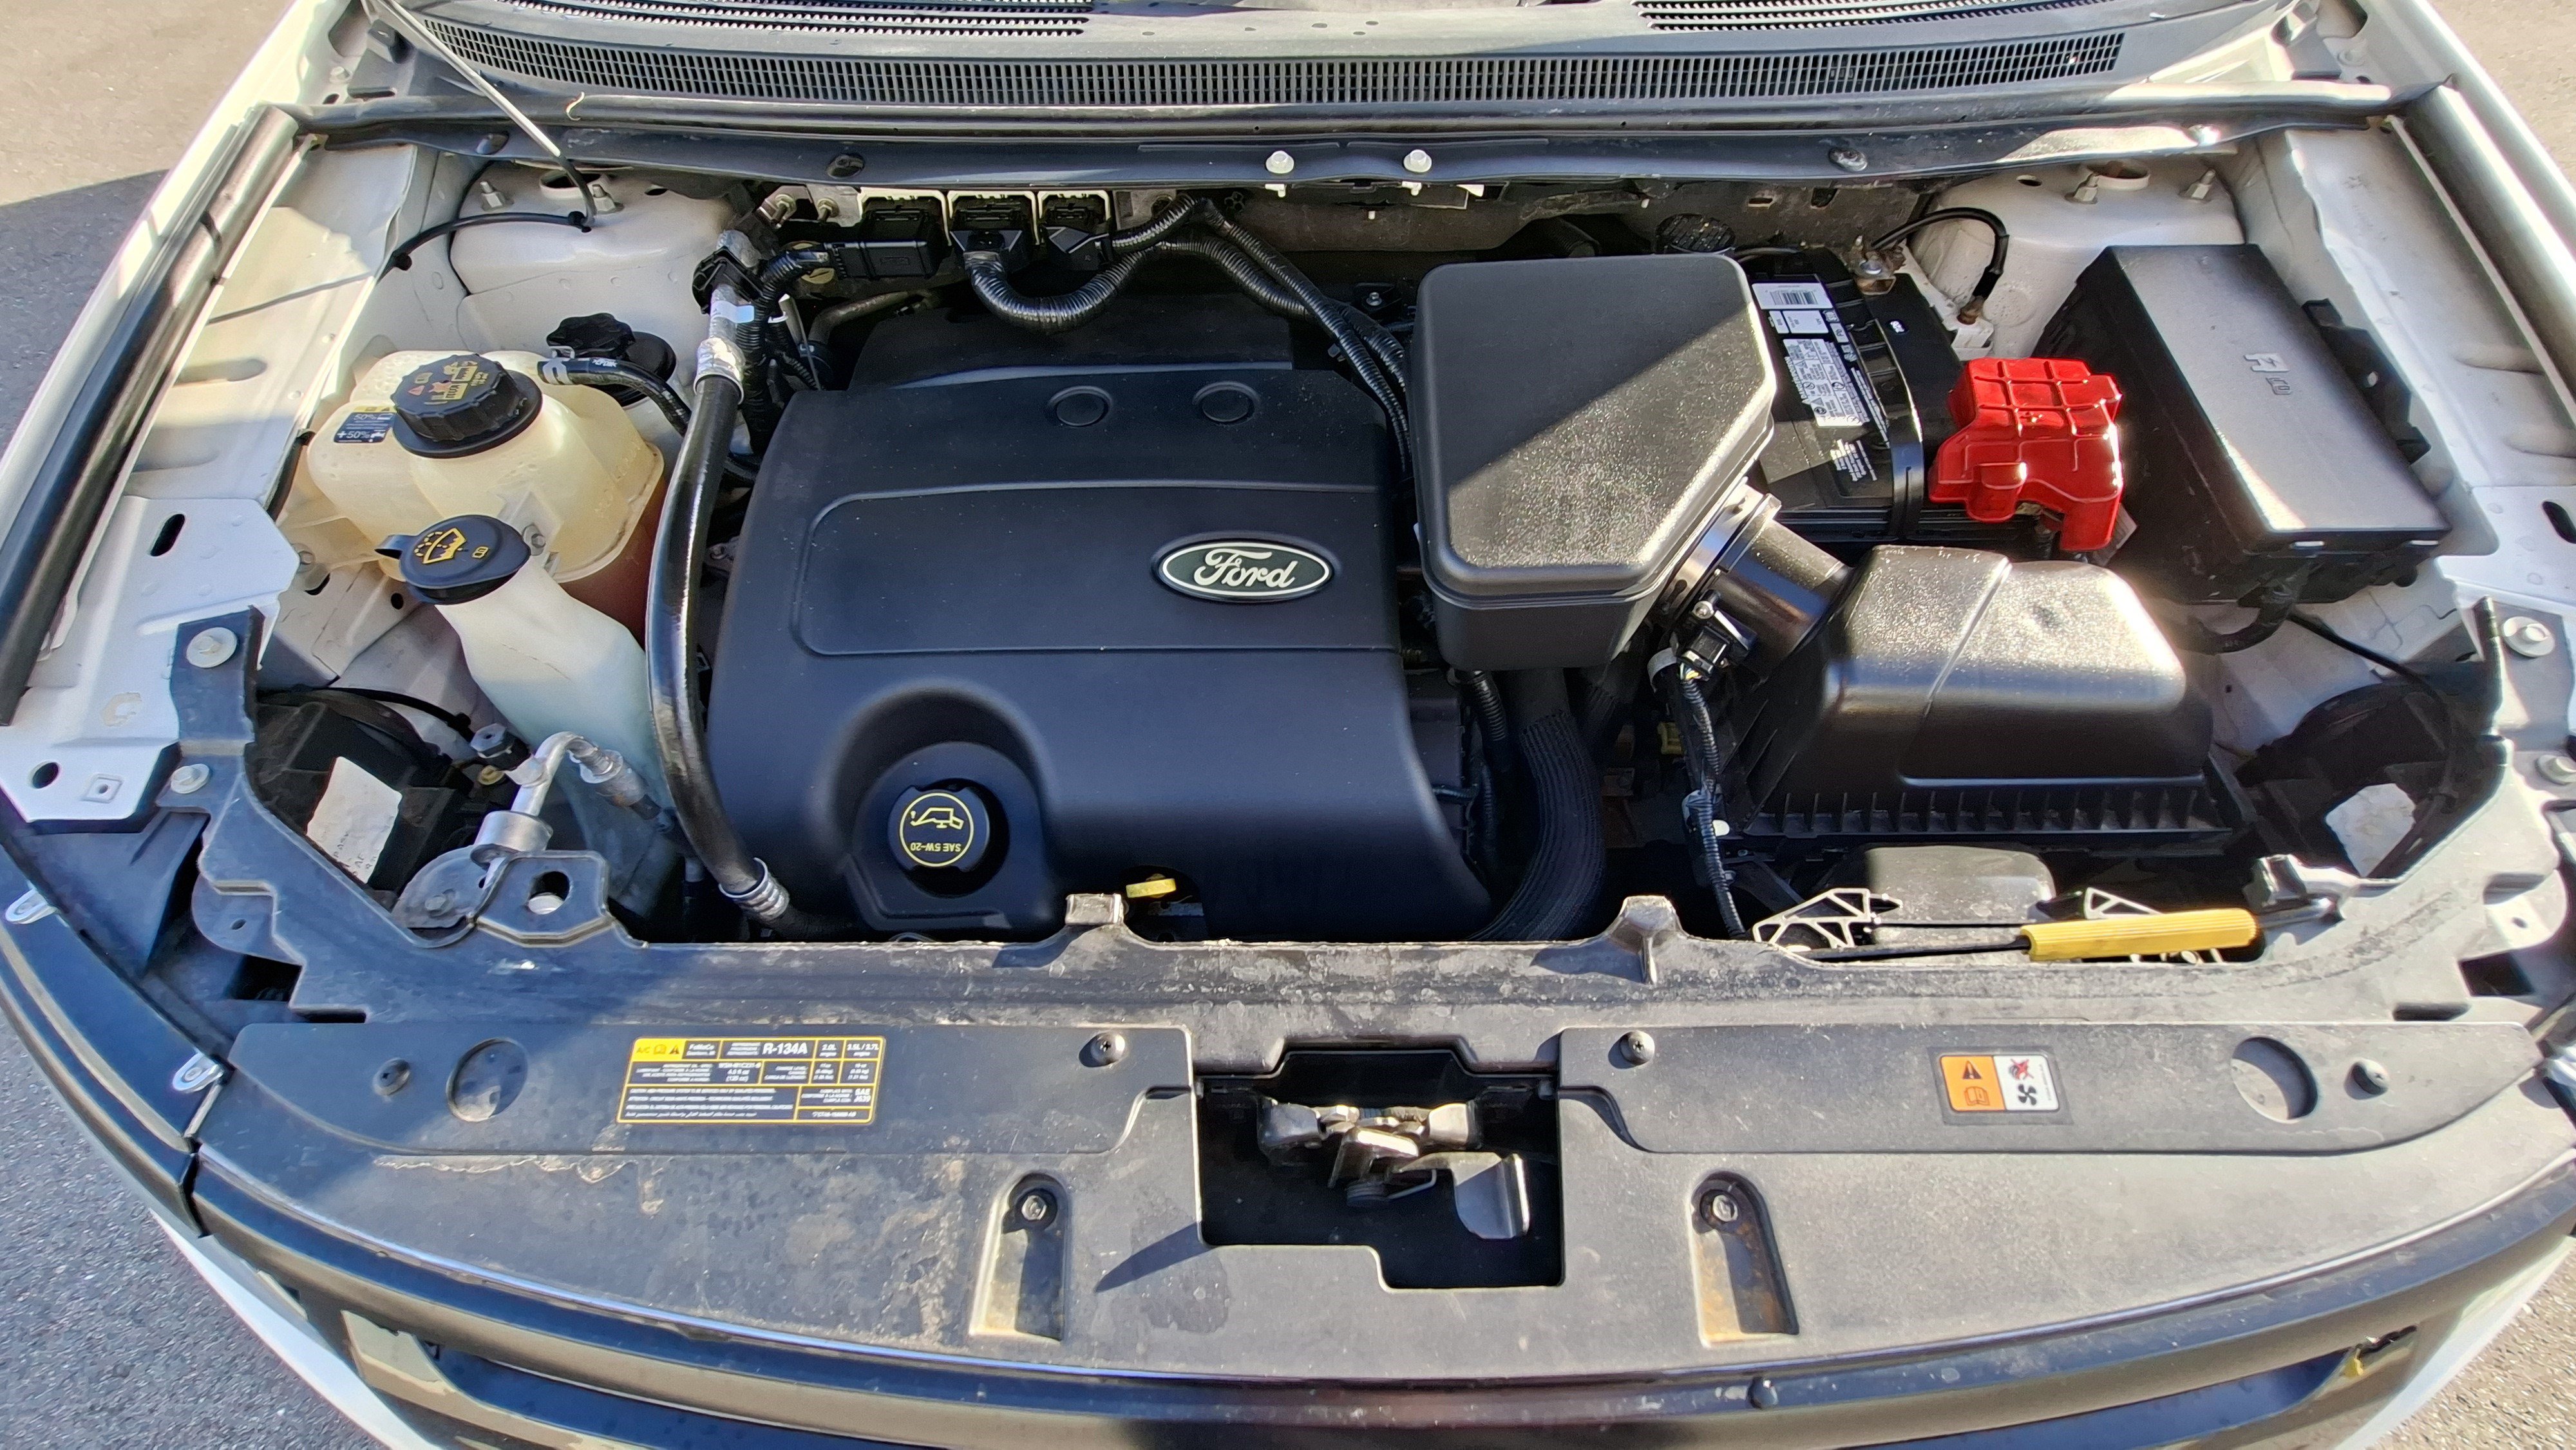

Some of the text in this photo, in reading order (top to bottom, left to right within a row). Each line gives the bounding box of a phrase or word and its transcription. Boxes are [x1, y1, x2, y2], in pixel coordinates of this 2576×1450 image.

[1193, 548, 1298, 588] Ford
[910, 842, 961, 852] SAE 5W-20
[762, 1042, 808, 1055] R-134A
